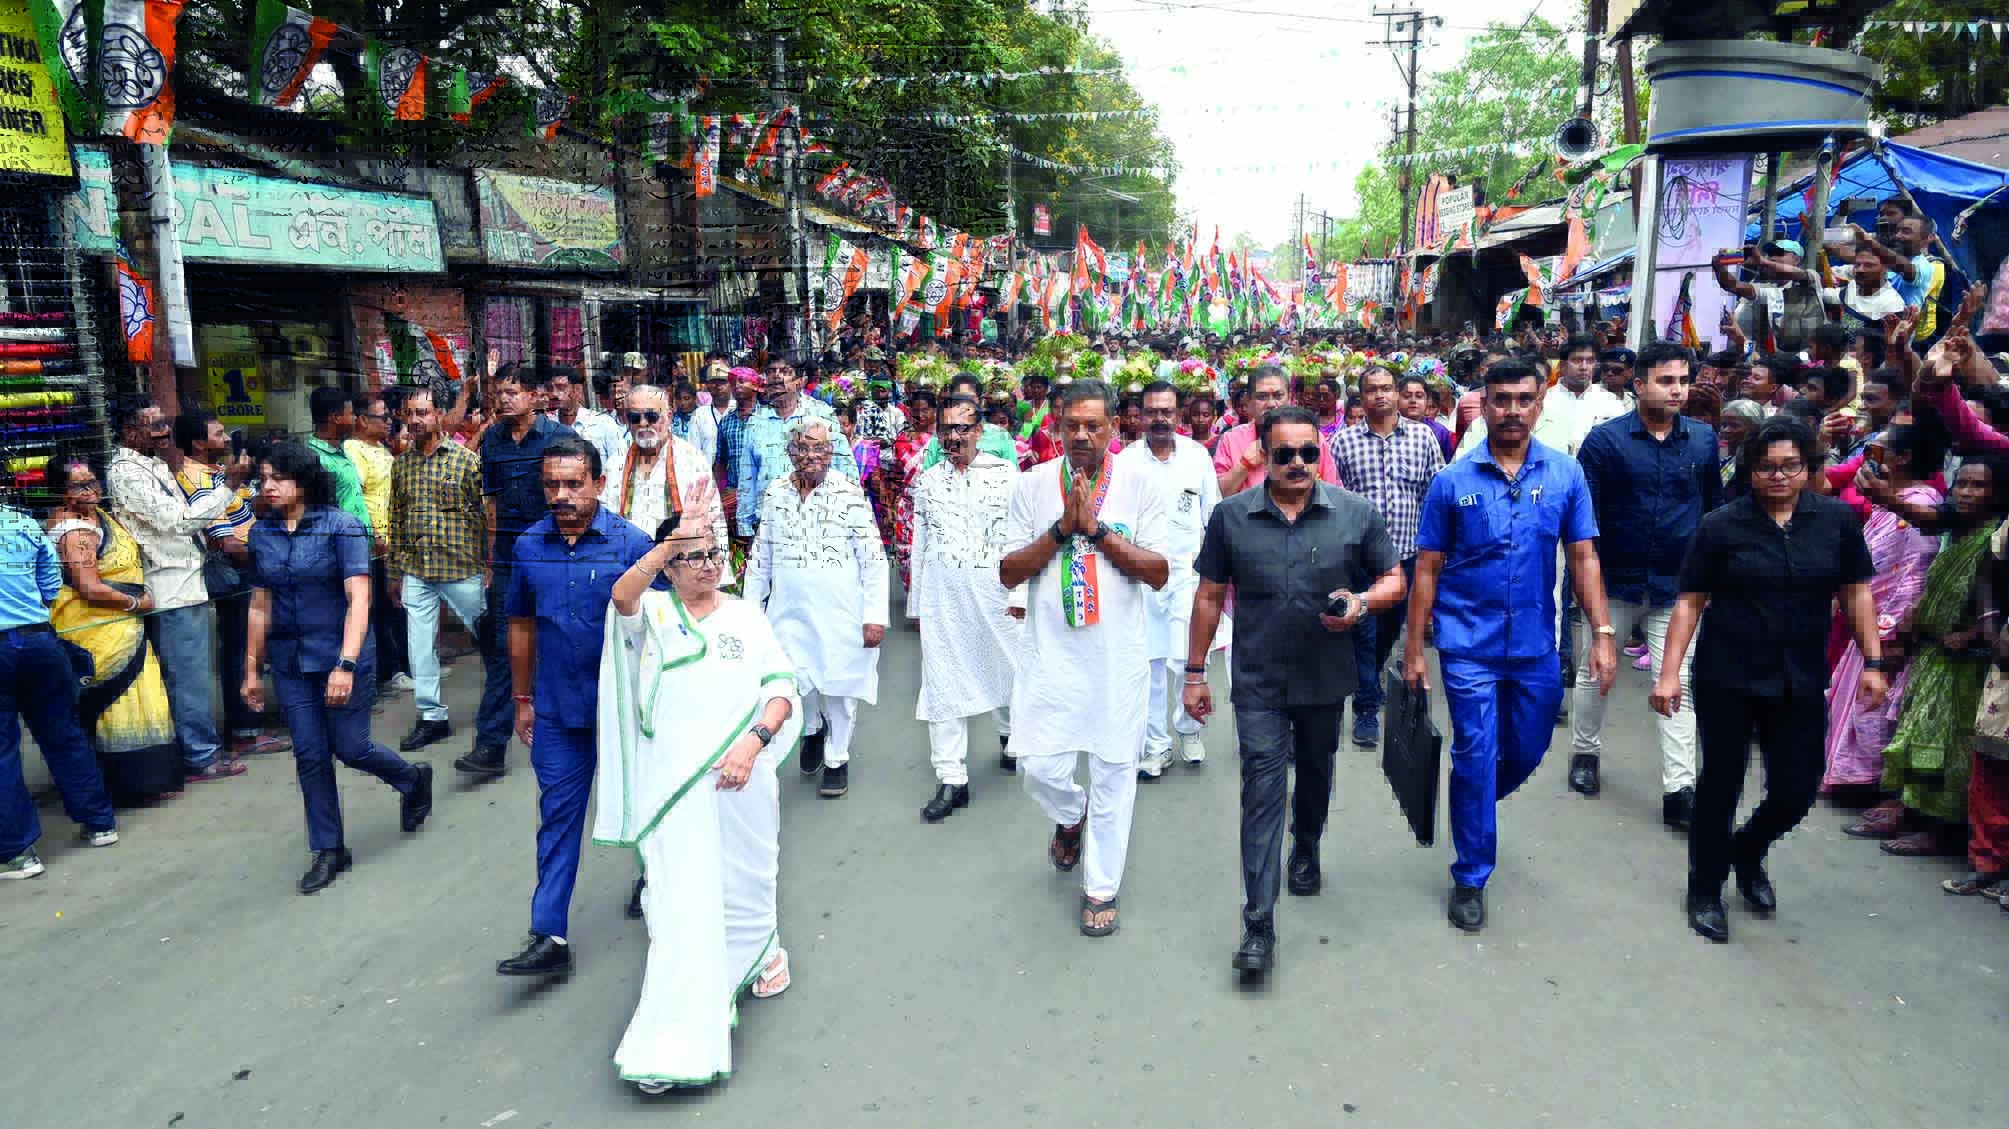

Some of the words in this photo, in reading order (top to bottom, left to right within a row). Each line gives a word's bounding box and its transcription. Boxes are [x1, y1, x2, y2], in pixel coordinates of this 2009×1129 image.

[1441, 192, 1468, 205] POPULAR
[223, 369, 252, 402] 1
[217, 404, 264, 416] CRORE
